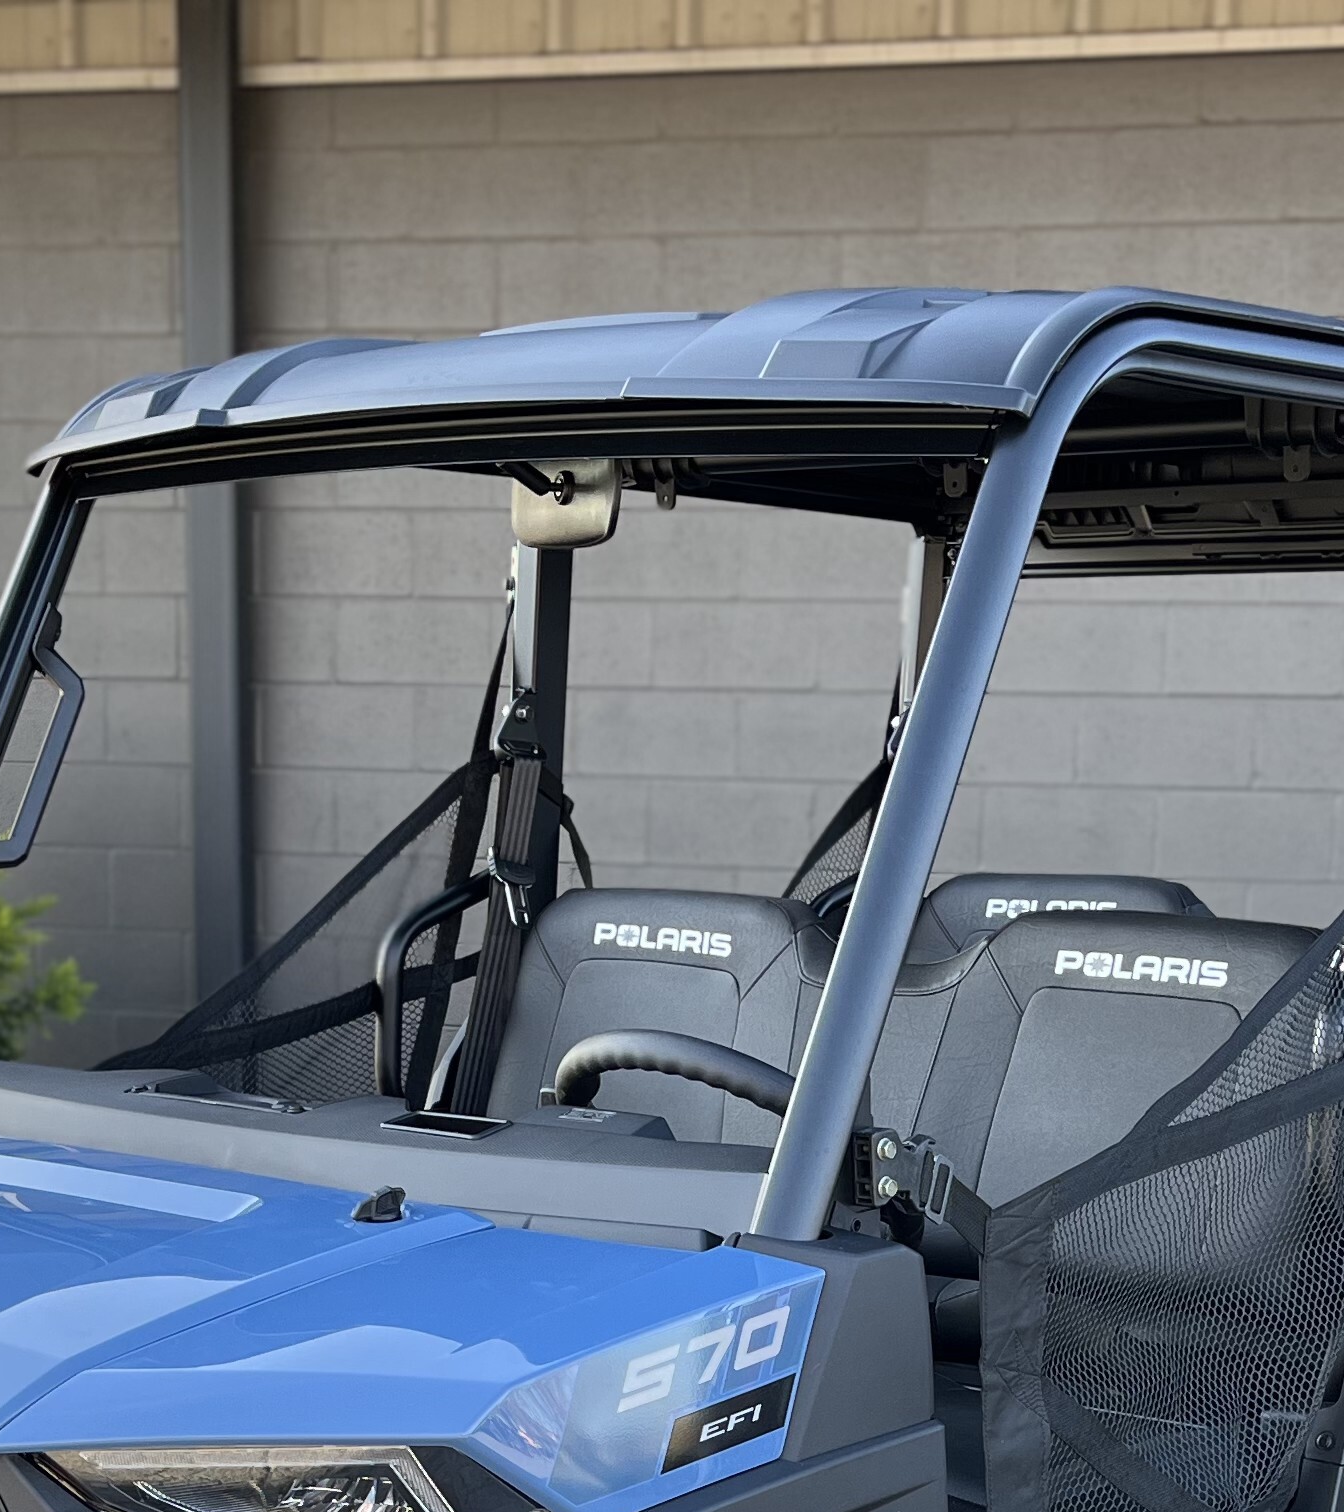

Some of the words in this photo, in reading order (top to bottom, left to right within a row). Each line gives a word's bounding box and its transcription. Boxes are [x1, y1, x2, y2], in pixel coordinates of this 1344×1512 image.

[593, 922, 732, 958] POLARIS
[1055, 949, 1228, 988] POLARIS
[617, 1305, 790, 1414] 570
[699, 1403, 762, 1443] EFI
